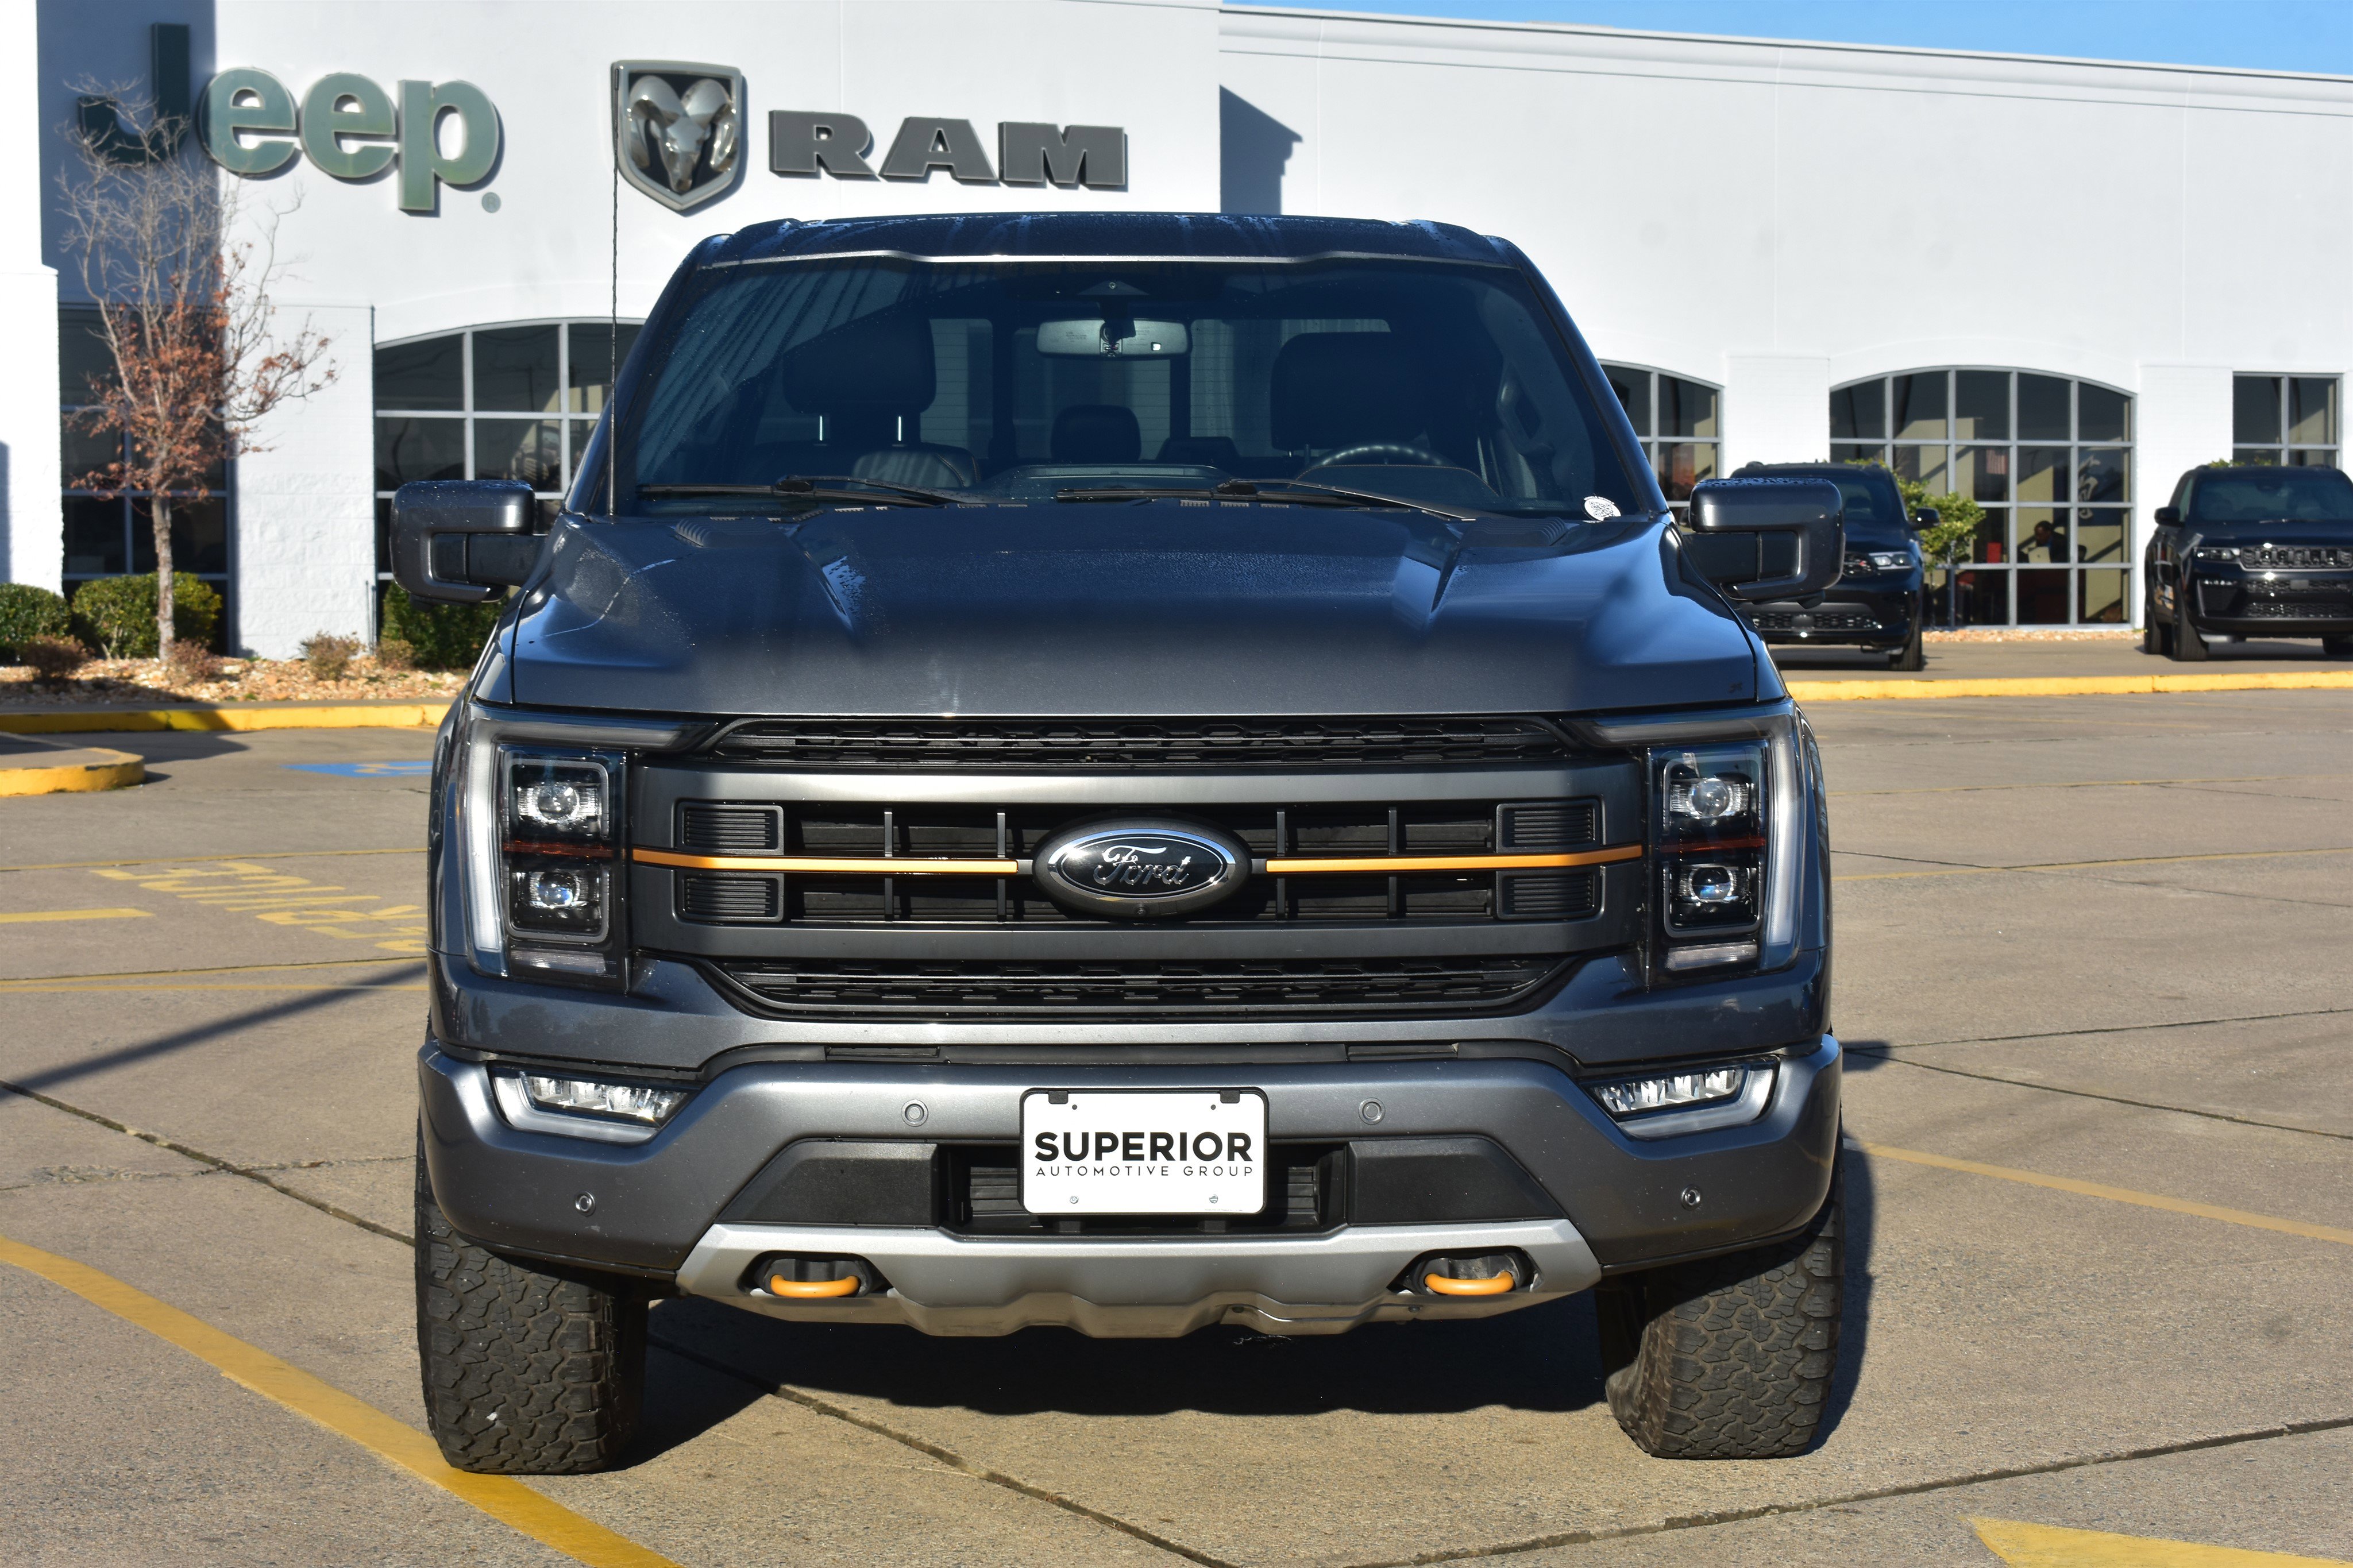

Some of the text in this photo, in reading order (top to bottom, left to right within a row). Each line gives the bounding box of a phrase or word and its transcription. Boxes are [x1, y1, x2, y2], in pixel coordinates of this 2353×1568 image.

[769, 110, 1127, 187] RAM
[1093, 845, 1191, 885] Ford
[1035, 1131, 1253, 1161] SUPERIOR
[1035, 1166, 1253, 1176] AUTOMOTIVE GROUP
